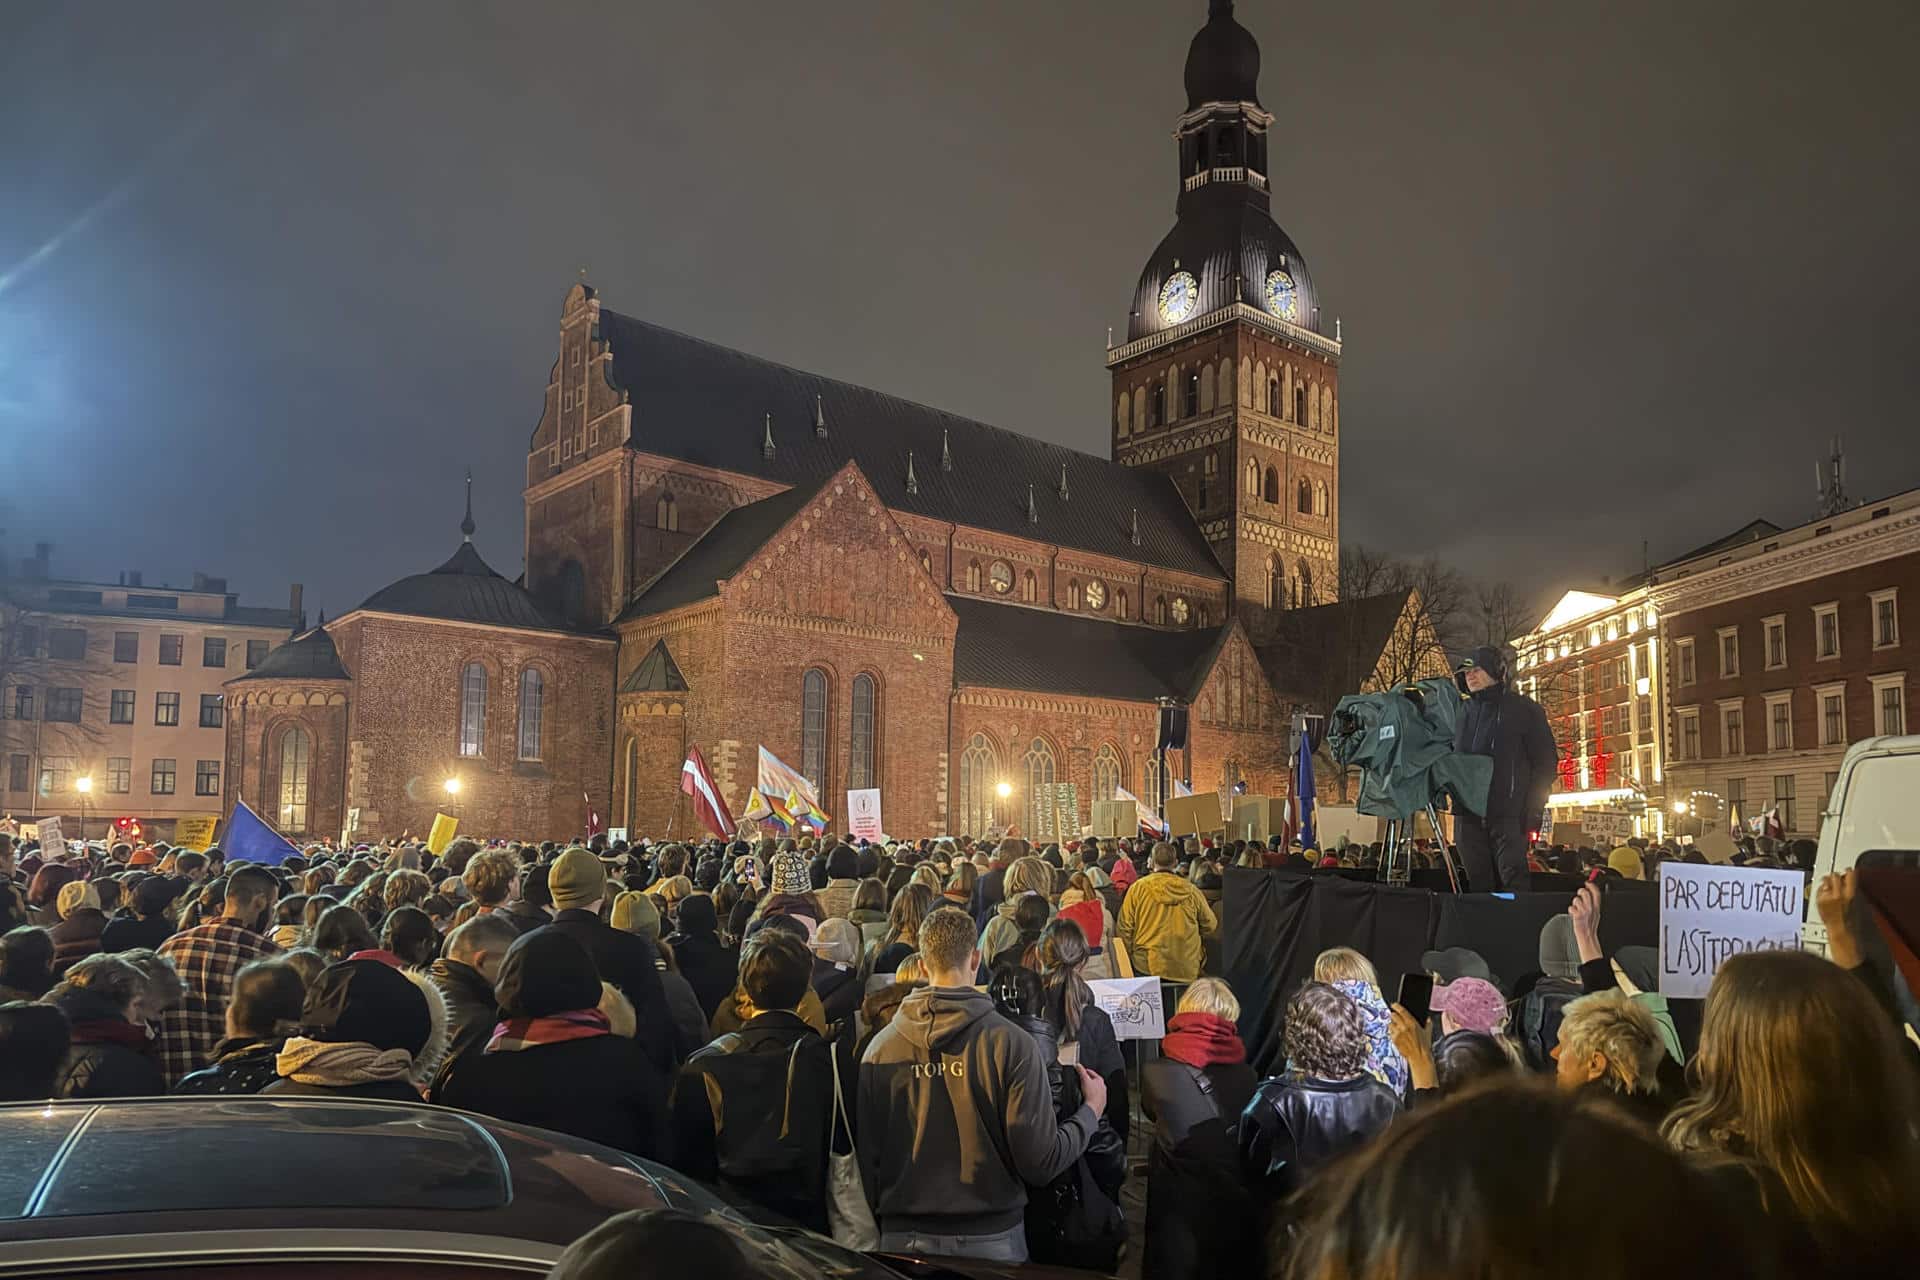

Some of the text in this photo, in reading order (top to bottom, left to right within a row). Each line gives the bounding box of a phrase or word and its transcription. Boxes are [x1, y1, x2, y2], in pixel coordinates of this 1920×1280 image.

[1664, 875, 1796, 916] PAR DEPUTĀTU
[1664, 924, 1799, 976] LASĪTP
[911, 1061, 963, 1078] TOP G
